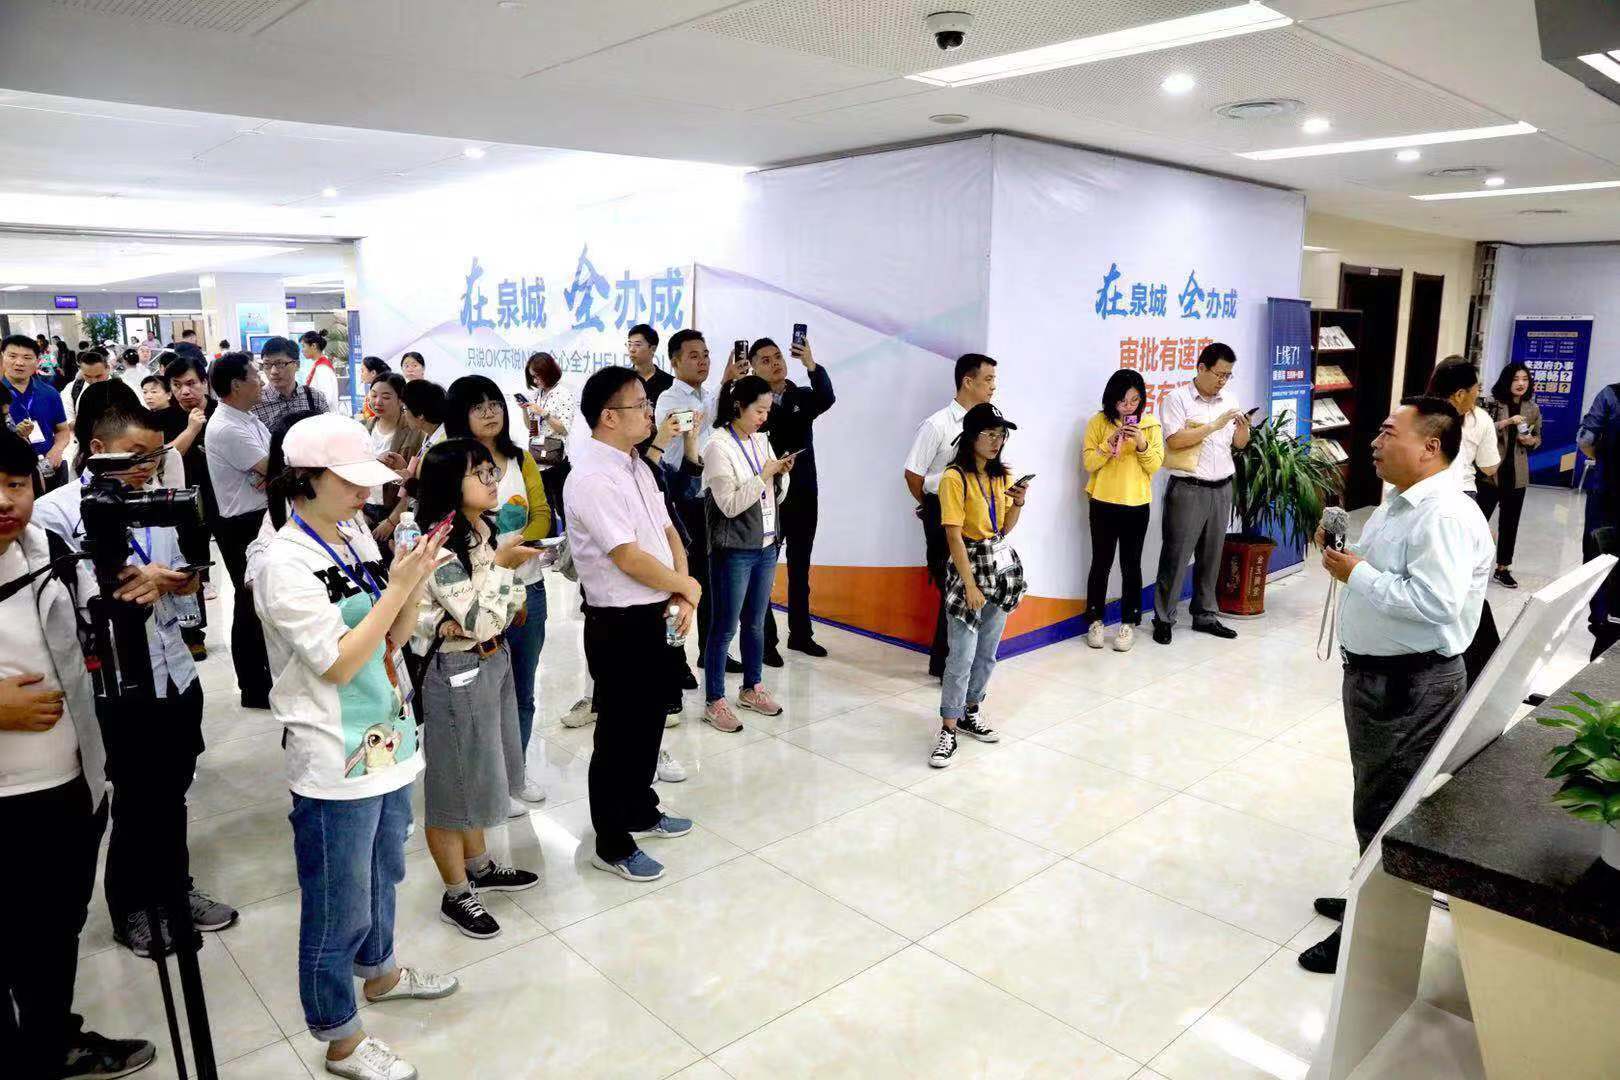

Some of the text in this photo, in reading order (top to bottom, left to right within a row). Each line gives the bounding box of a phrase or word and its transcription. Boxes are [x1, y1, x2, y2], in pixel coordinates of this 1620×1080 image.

[460, 257, 547, 335] 在泉城
[1095, 263, 1168, 320] 在泉城
